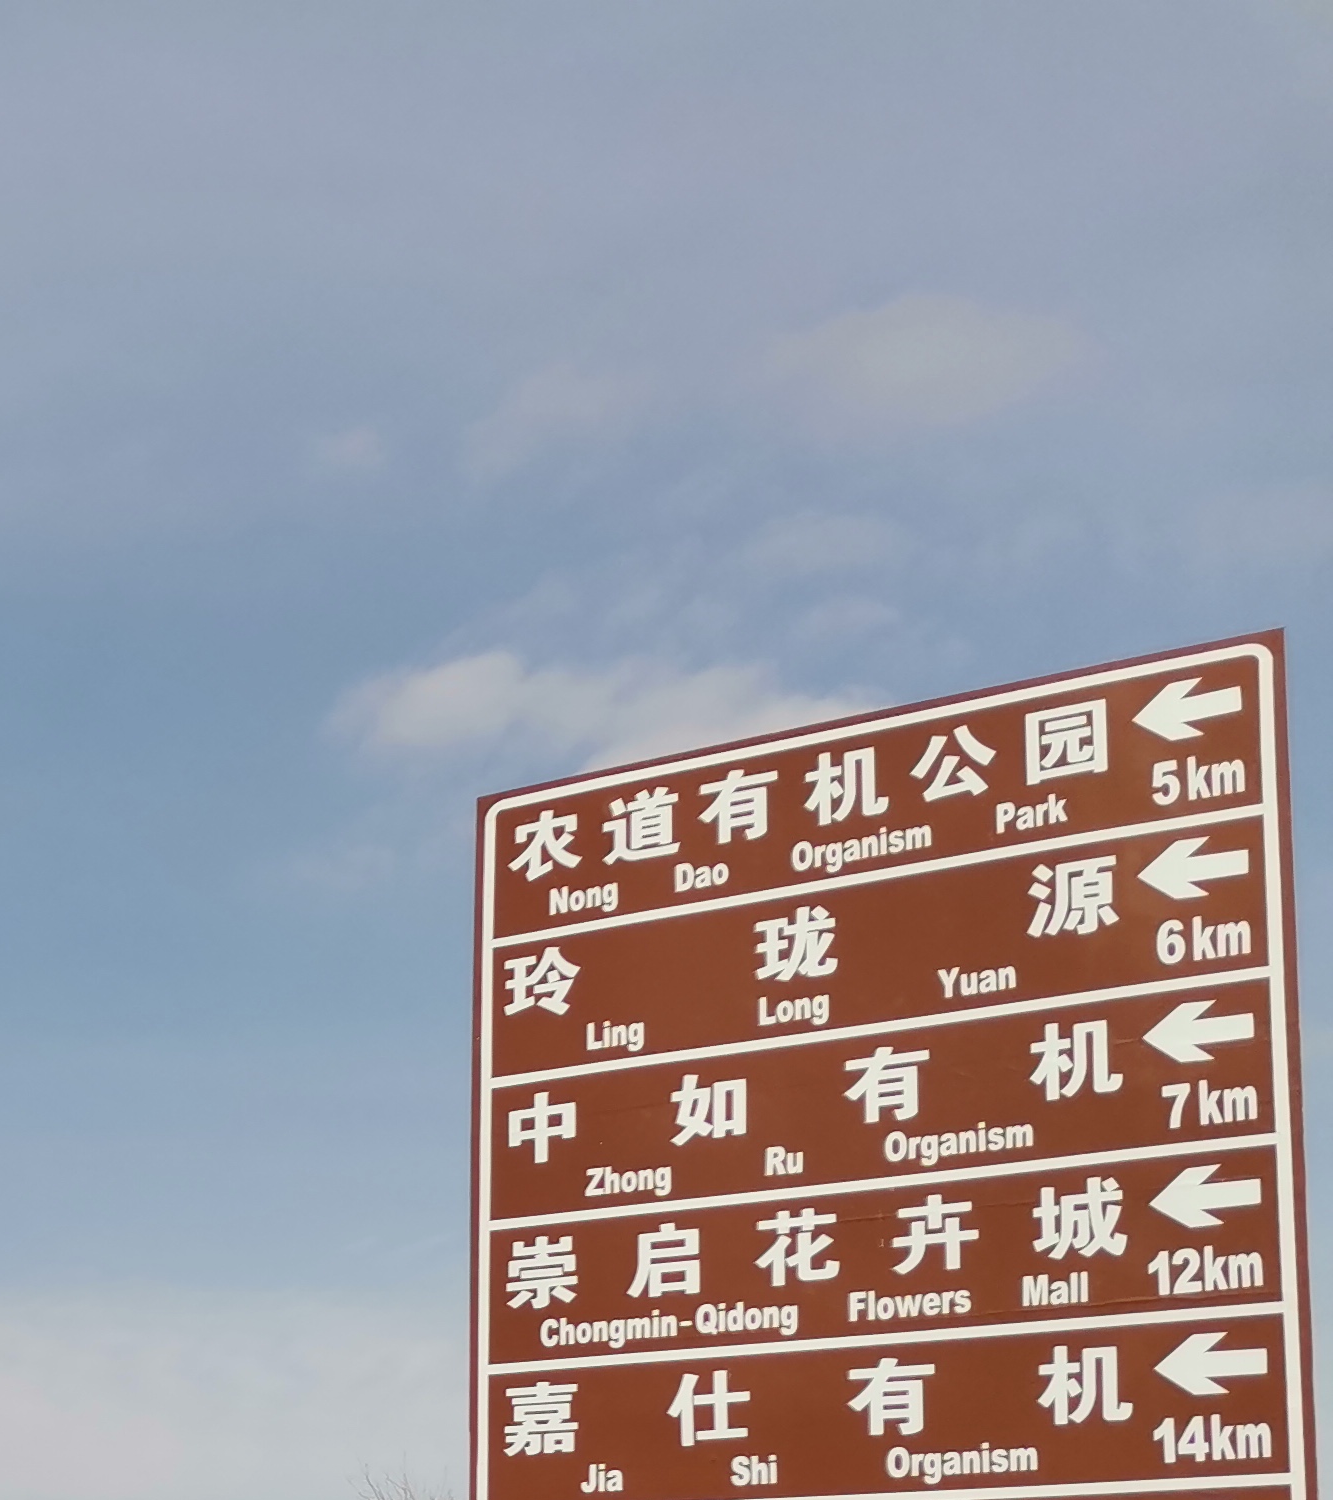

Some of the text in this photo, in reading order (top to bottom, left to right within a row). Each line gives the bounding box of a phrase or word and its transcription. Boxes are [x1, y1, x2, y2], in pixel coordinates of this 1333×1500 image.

[509, 698, 1108, 883] 农道有机公园
[1152, 755, 1246, 806] 5km
[549, 793, 1068, 916] Nong Dao Organism Park
[503, 855, 1118, 1016] 玲珑源
[1156, 915, 1252, 965] 6km
[586, 965, 1017, 1052] Ling Long Yuan
[508, 1020, 1123, 1164] 中如有机
[1161, 1079, 1258, 1129] 7km
[584, 1121, 1034, 1197] Zhong Ru Organism
[506, 1176, 1128, 1310] 崇启花卉城
[1147, 1245, 1264, 1296] 12km
[540, 1271, 1089, 1349] Chongmin-Qidong Flowers Mall
[504, 1346, 1133, 1457] 嘉仕有机
[1152, 1413, 1272, 1464] 14km
[580, 1442, 1038, 1493] Jia Shi Organism
